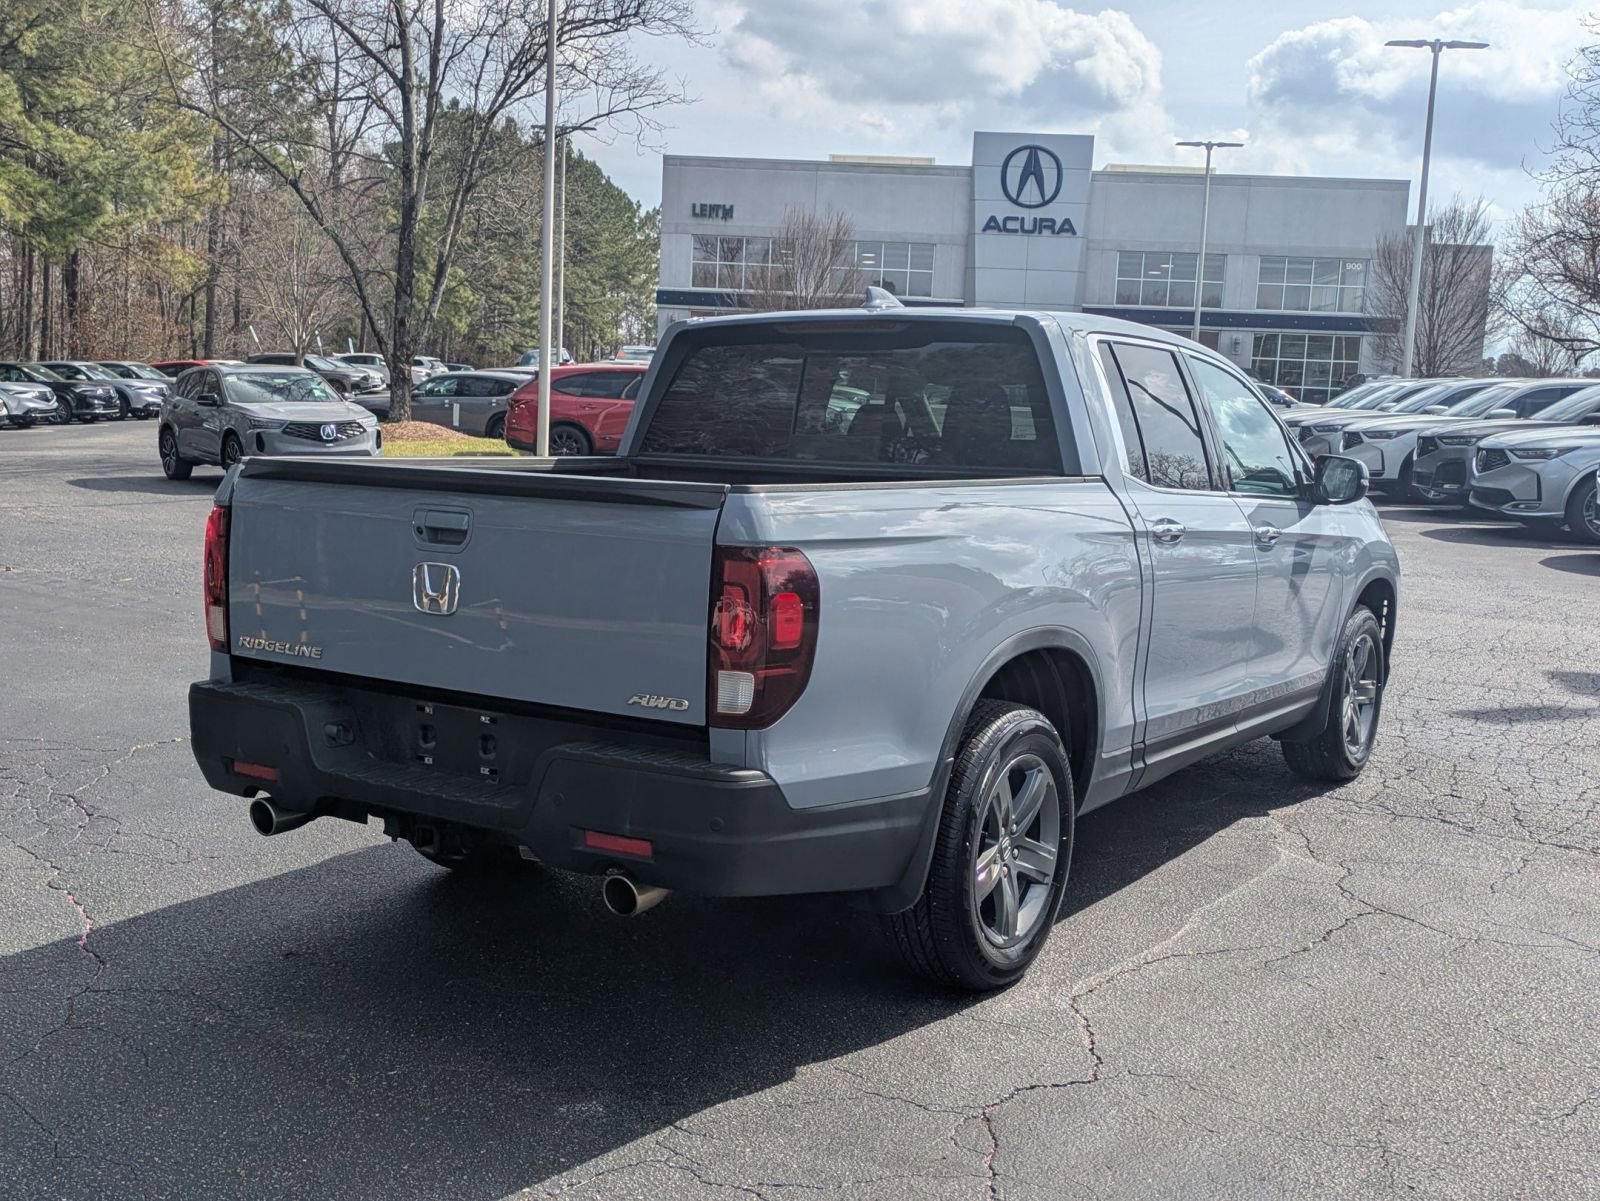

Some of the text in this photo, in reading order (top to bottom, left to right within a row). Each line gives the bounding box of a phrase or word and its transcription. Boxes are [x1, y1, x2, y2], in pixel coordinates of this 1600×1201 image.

[692, 202, 734, 219] LEITH
[981, 215, 1077, 235] ACURA
[1346, 262, 1362, 270] 900
[239, 635, 323, 659] RIDGELINE
[627, 693, 689, 711] AWD
